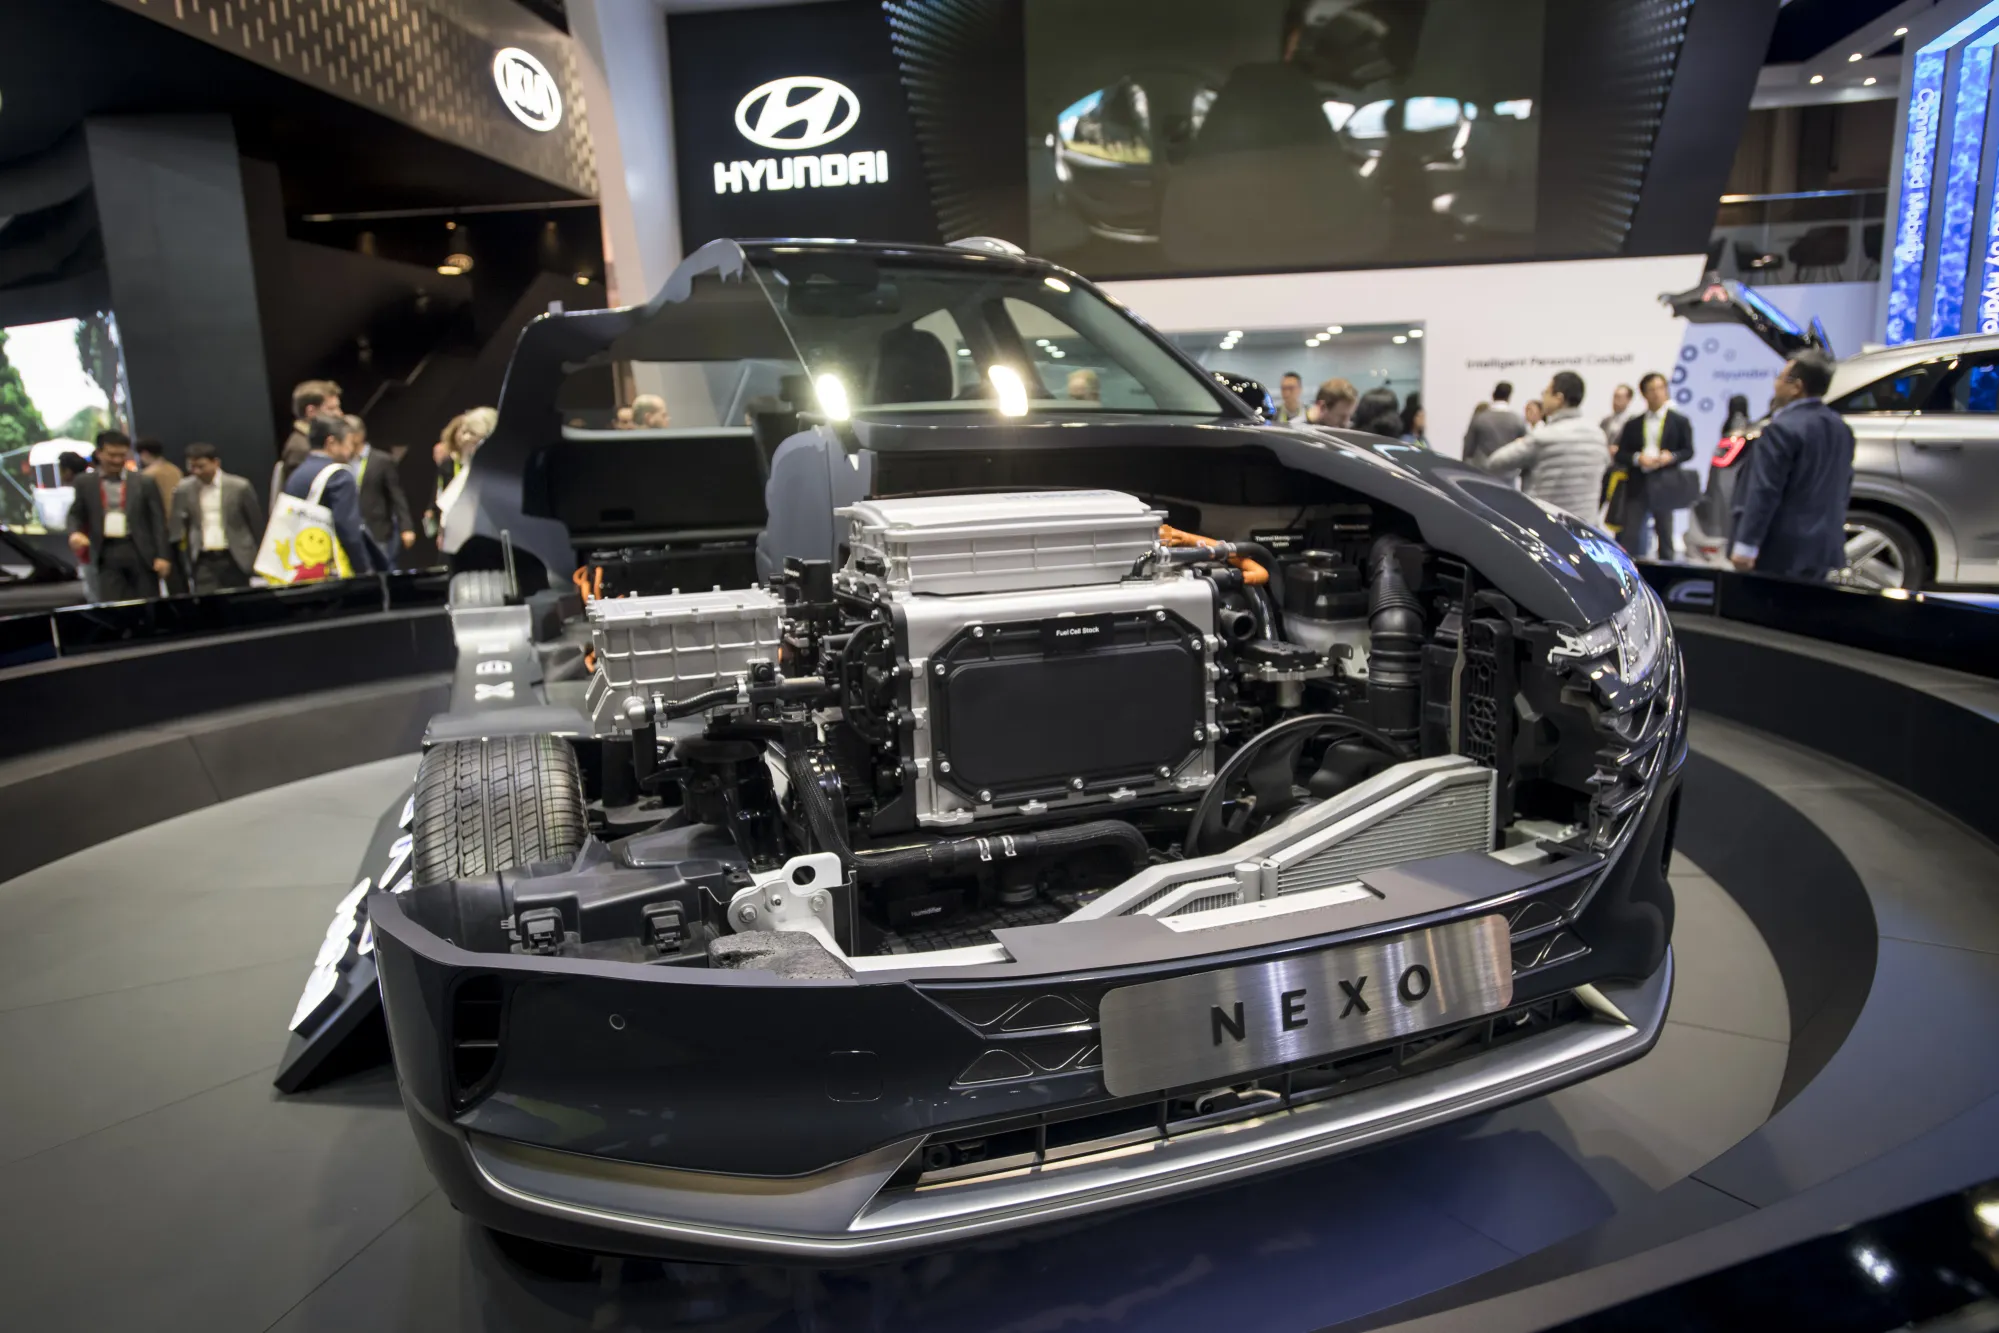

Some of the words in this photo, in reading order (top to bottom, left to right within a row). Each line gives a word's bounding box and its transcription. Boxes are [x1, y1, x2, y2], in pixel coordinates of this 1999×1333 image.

[1910, 88, 1935, 189] Connected
[714, 150, 888, 194] HYUNDAI
[1900, 192, 1925, 263] Mobility
[1467, 358, 1526, 370] Intelligent
[1531, 356, 1582, 367] Personal
[1587, 353, 1634, 366] Cockpit
[1082, 626, 1099, 634] Stack
[1211, 964, 1431, 1046] NEXO
